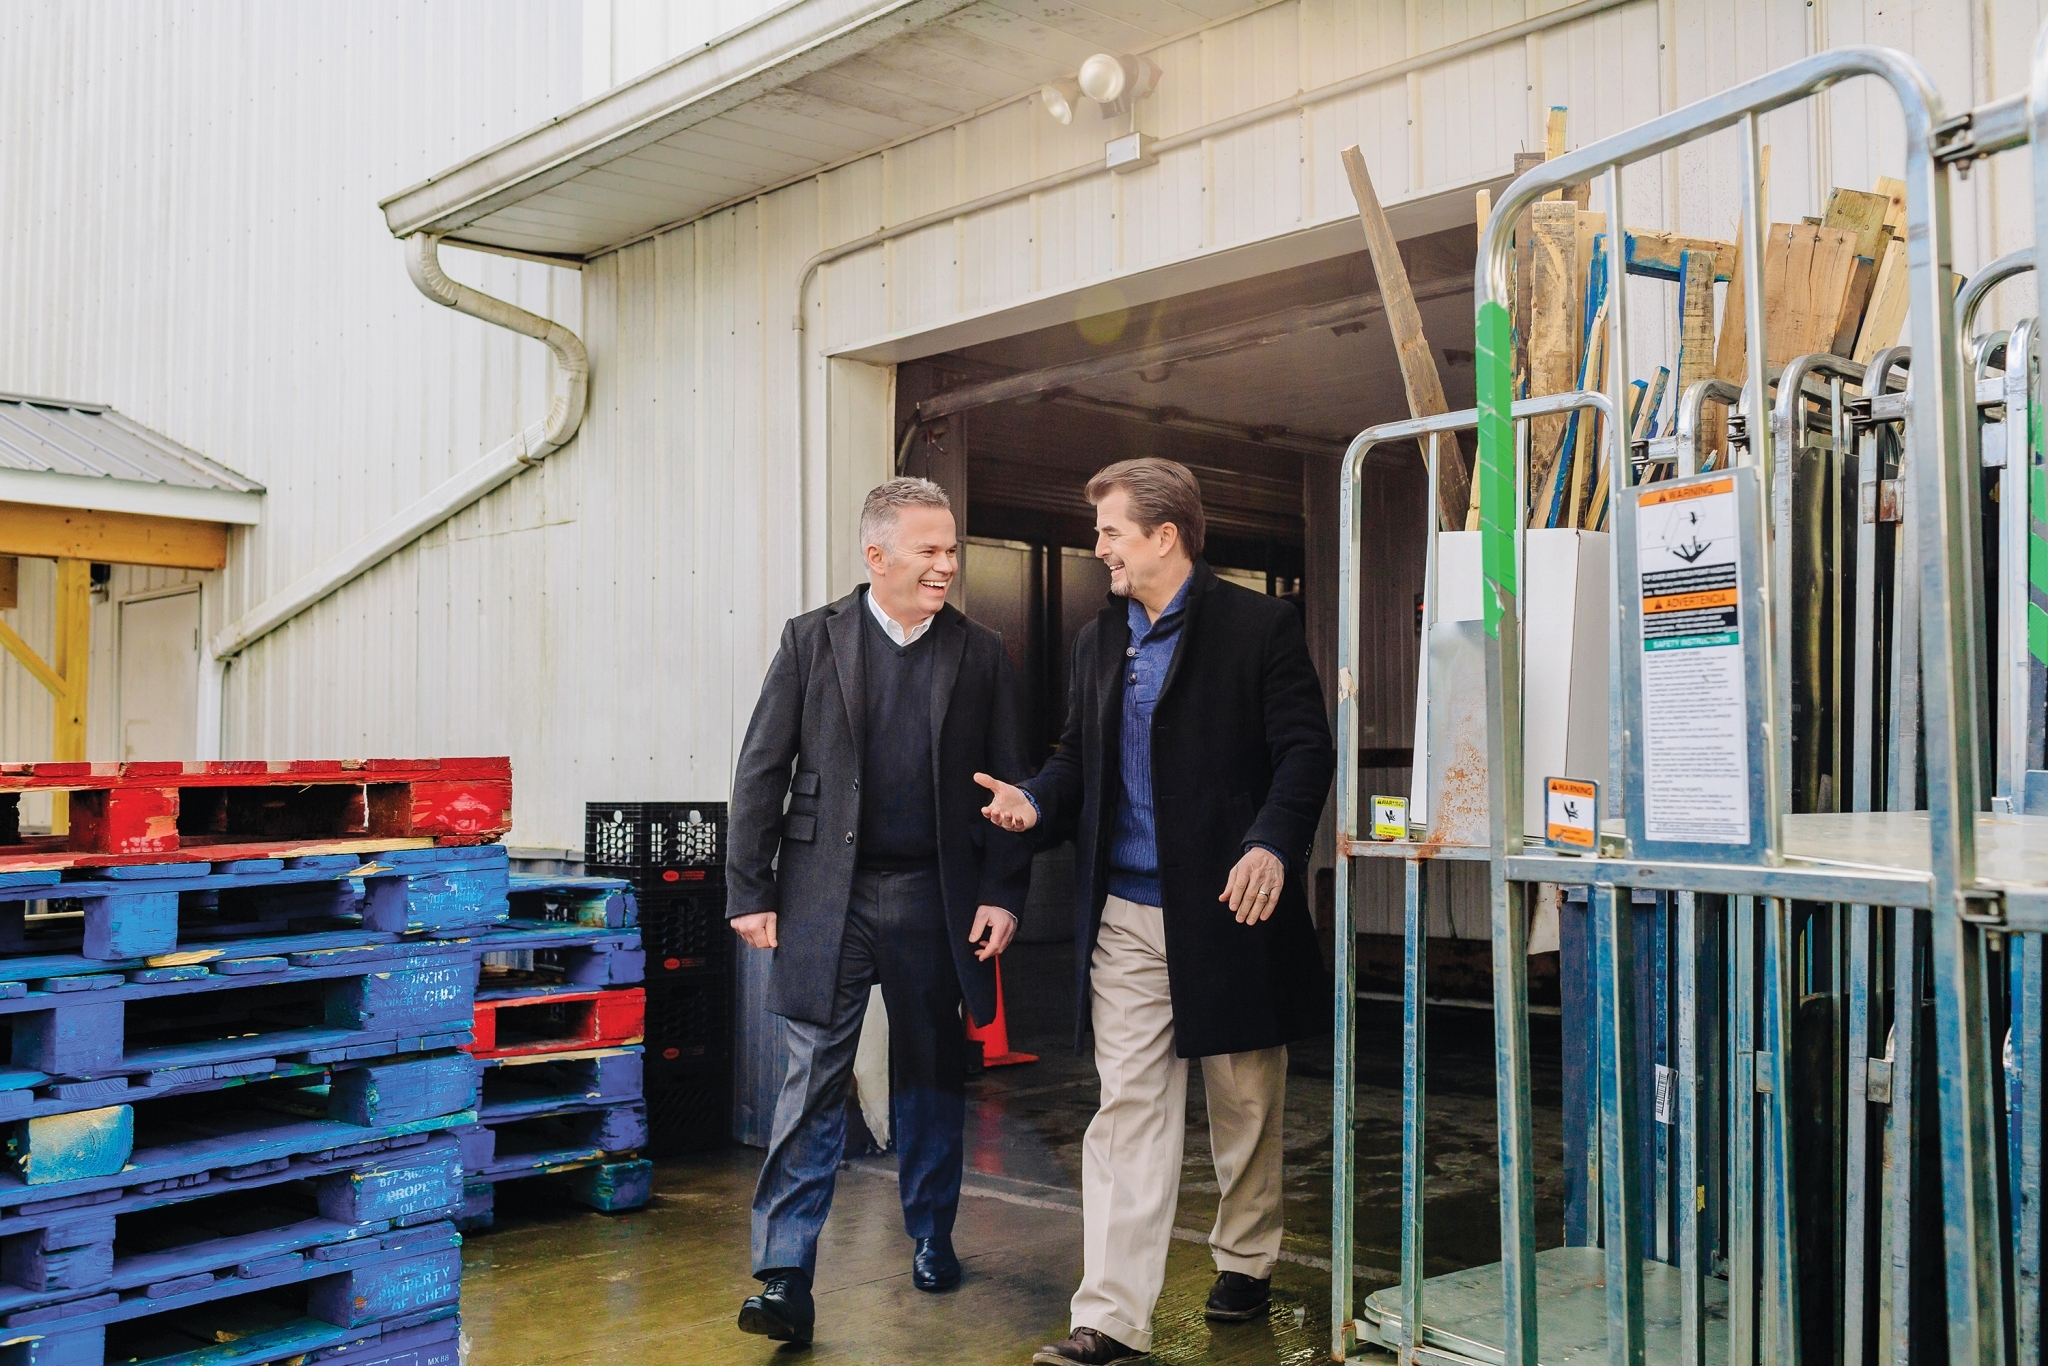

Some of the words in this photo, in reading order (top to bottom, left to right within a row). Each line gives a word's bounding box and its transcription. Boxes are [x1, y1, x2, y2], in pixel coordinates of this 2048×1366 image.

[1668, 484, 1714, 499] WARNING
[1666, 593, 1727, 608] ADVERTENCIA
[1653, 639, 1680, 649] SAFETY
[1681, 635, 1731, 647] INSTRUCTIONS
[1558, 783, 1593, 796] WARNING
[415, 1283, 452, 1306] CHEP
[427, 1356, 440, 1366] MX
